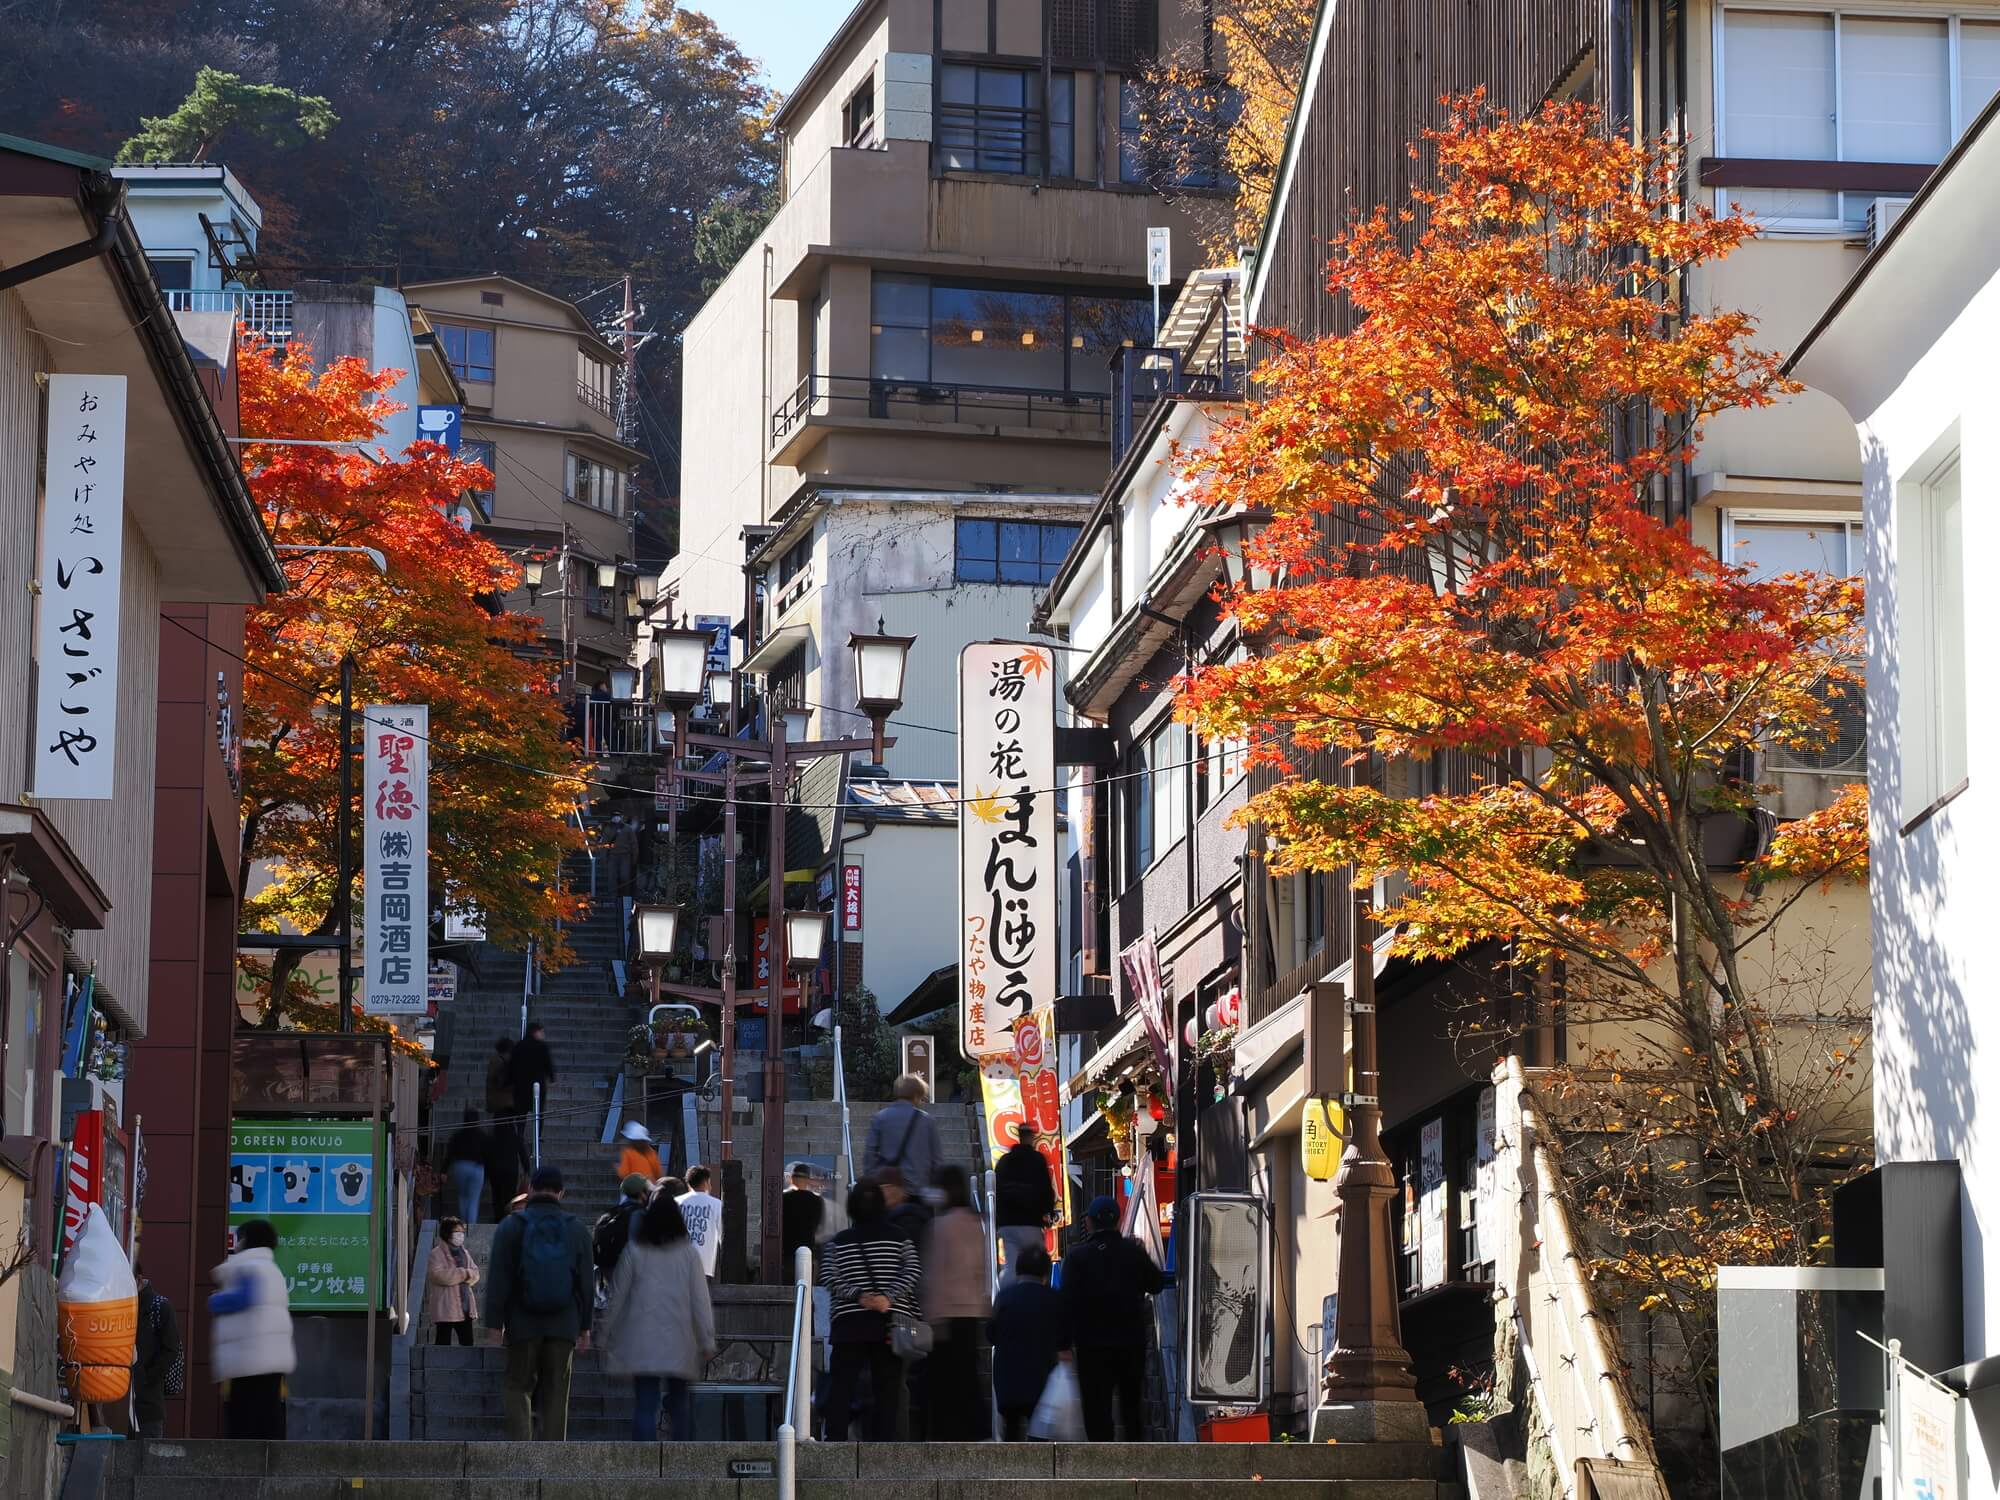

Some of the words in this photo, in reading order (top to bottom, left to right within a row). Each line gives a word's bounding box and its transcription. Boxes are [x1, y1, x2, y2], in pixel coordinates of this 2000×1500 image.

[69, 390, 98, 535] おみやげ処
[49, 554, 104, 767] いさごや
[379, 717, 415, 727] 地酒
[374, 733, 420, 821] 聖徳
[371, 994, 421, 1005] 0279-72-2292
[967, 914, 987, 1047] つたや物産店
[243, 1136, 286, 1146] GREEN
